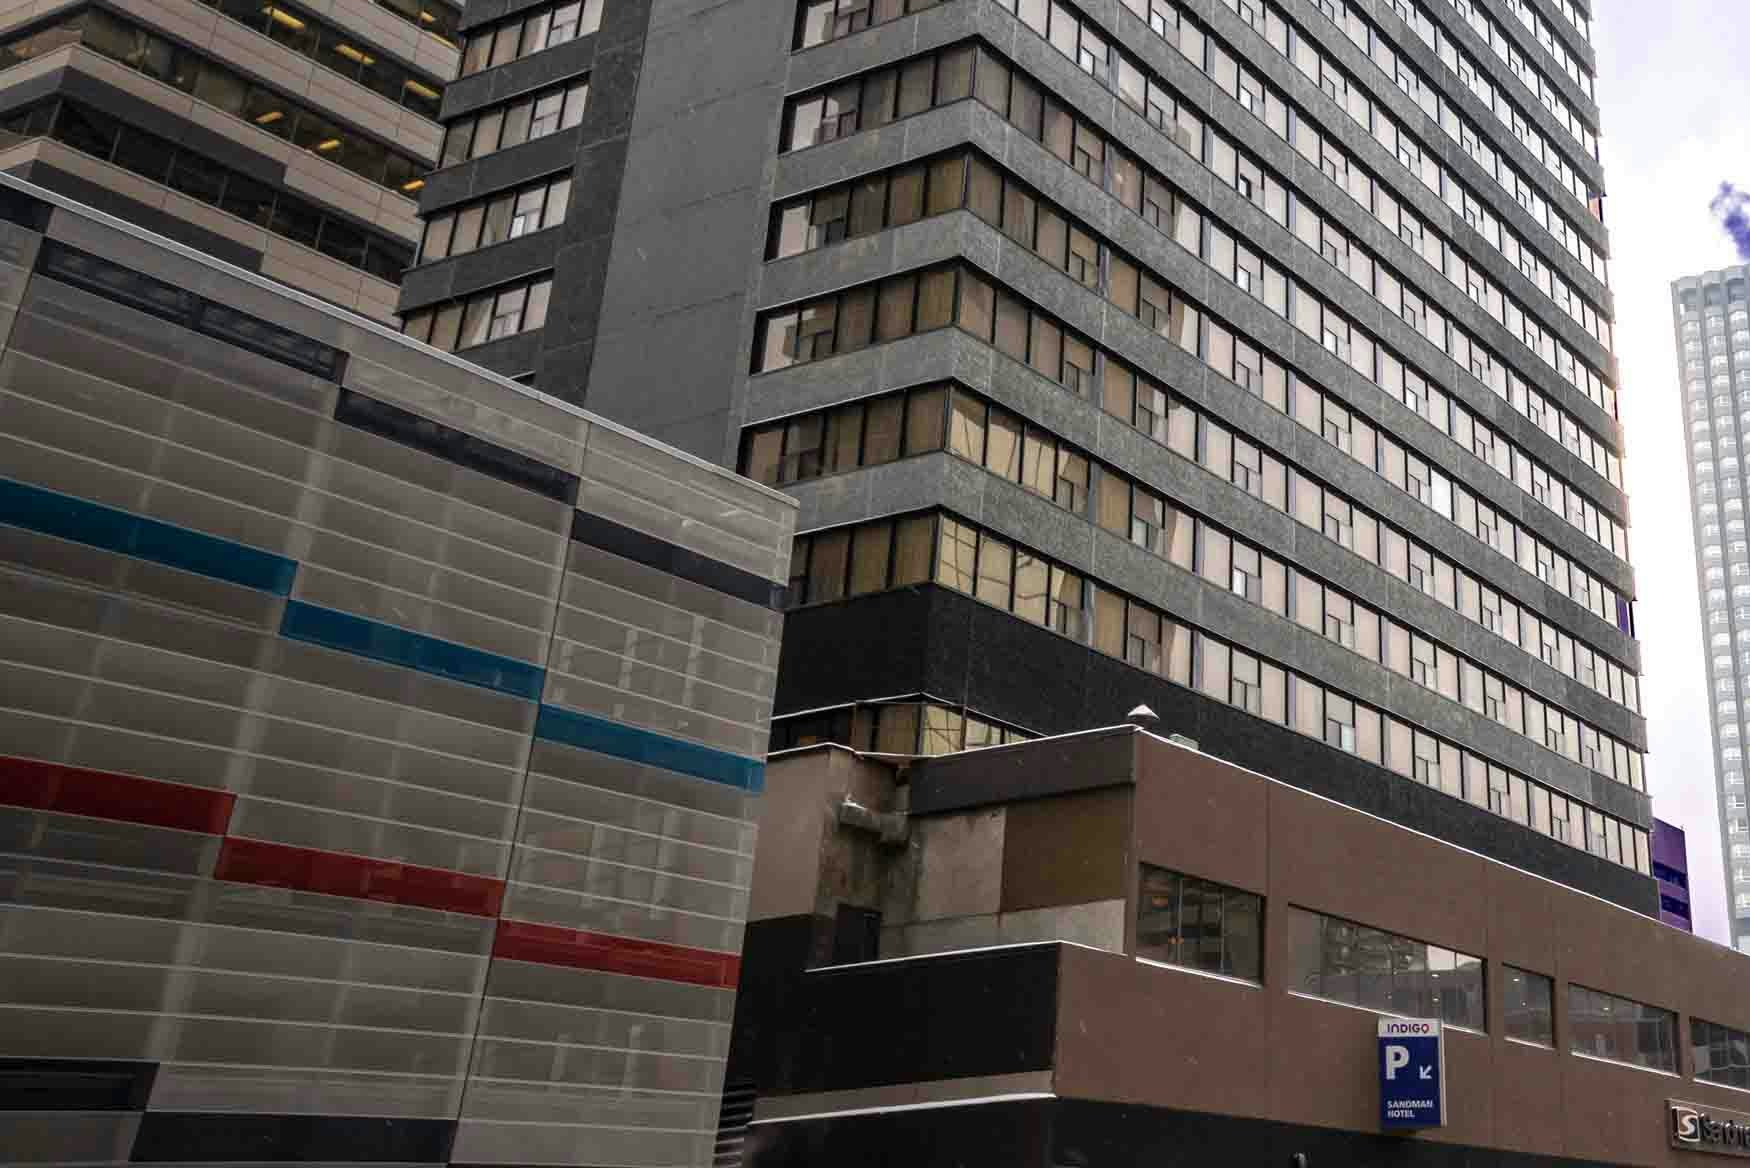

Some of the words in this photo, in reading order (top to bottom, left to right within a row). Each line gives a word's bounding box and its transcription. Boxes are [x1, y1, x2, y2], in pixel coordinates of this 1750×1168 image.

[1387, 1023, 1430, 1034] INDIGO
[1385, 1045, 1410, 1080] P
[1387, 1100, 1433, 1109] SANDMAN
[1387, 1109, 1416, 1118] HOTEL
